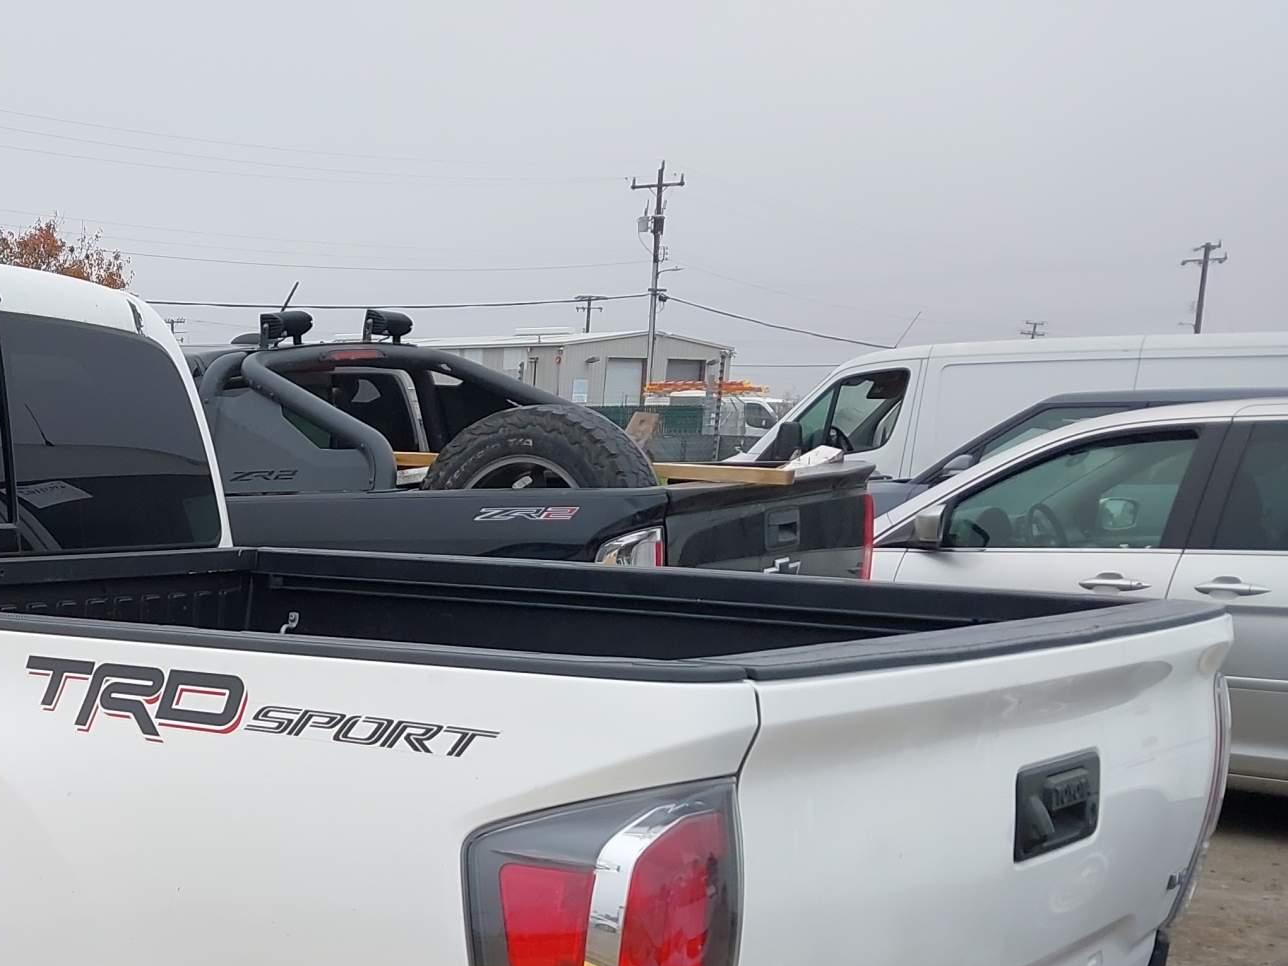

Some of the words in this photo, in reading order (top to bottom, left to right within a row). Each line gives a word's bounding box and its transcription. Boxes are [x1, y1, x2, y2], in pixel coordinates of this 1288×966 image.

[229, 469, 299, 482] ZR2
[473, 506, 580, 521] ZR2
[26, 655, 248, 744] TRD
[244, 705, 500, 758] SPORT
